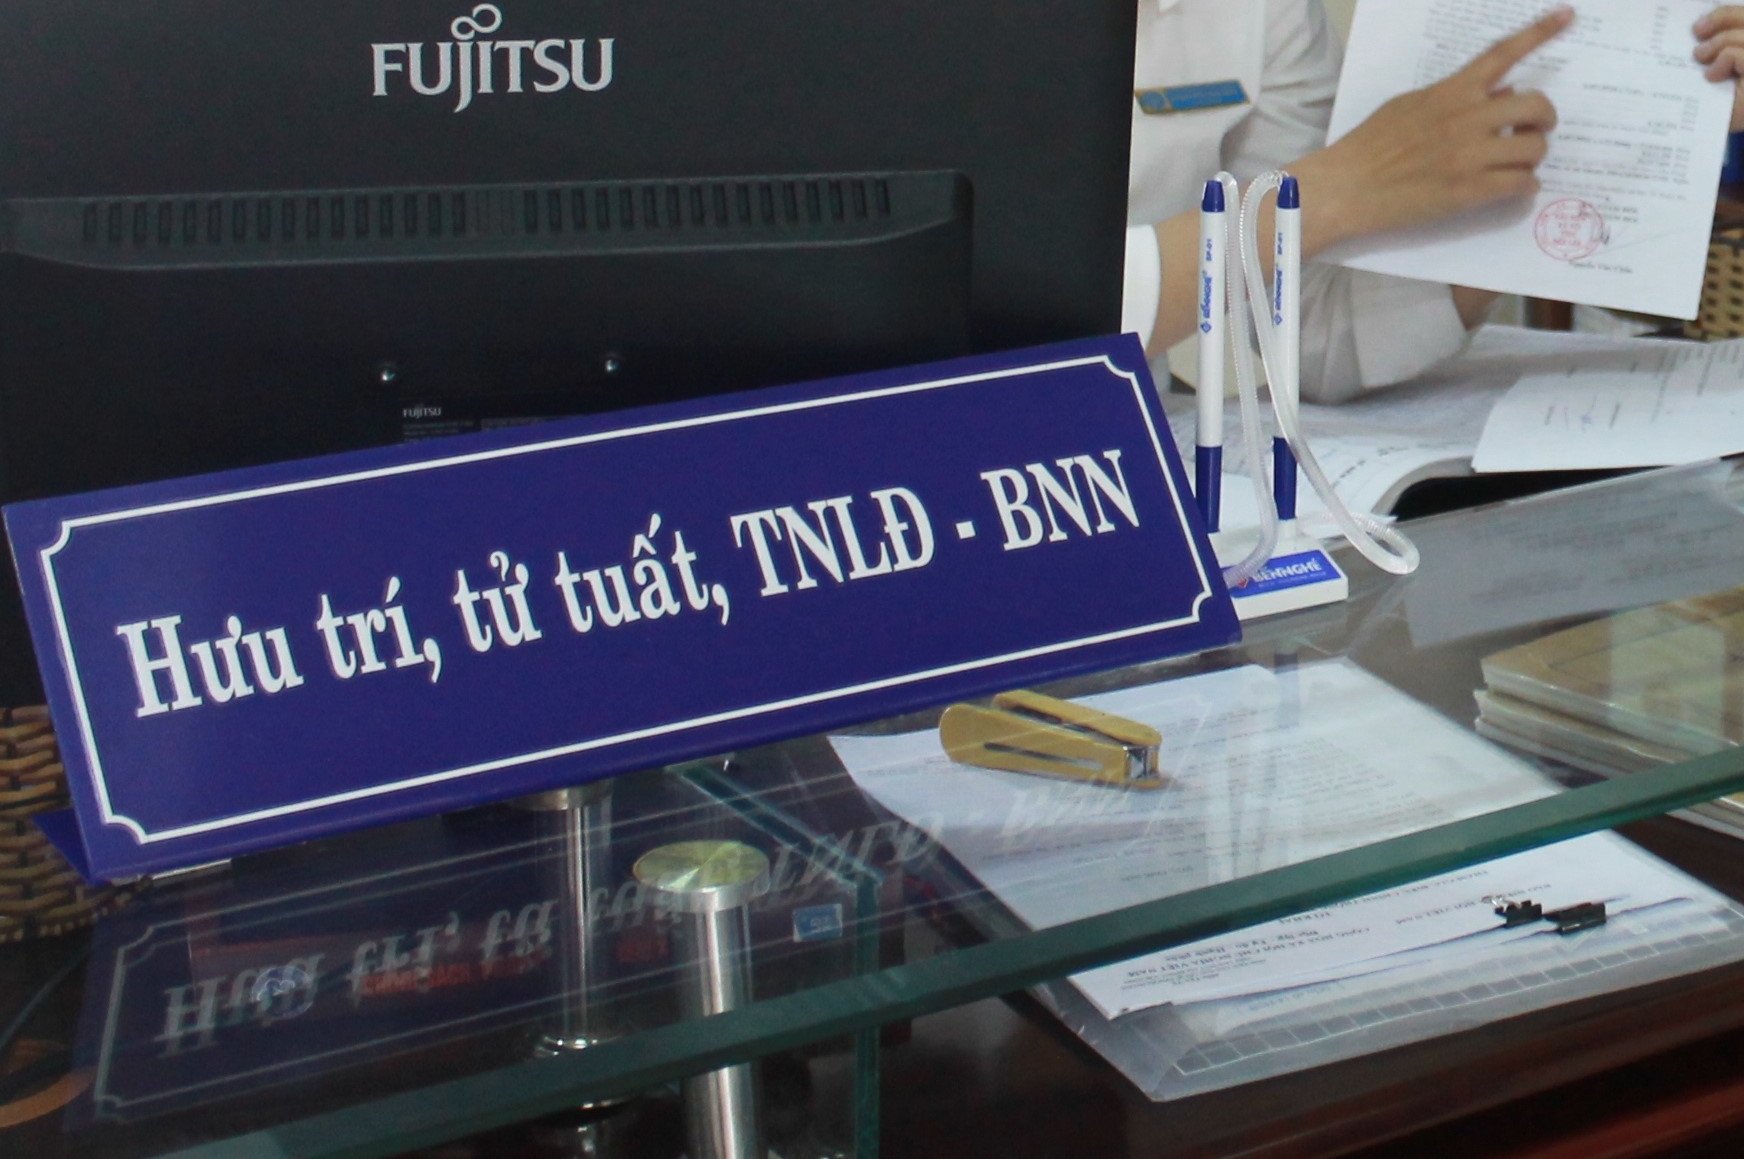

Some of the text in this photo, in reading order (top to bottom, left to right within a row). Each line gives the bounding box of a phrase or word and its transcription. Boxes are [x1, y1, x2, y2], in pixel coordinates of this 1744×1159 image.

[371, 39, 614, 112] FUJITSU
[402, 407, 442, 419] FUJITSU
[117, 616, 304, 718] Hưu
[316, 577, 441, 683] trí,
[452, 551, 542, 653] tử
[554, 509, 730, 633] tuất,
[730, 488, 934, 597] TNLĐ
[980, 449, 1140, 551] BNN
